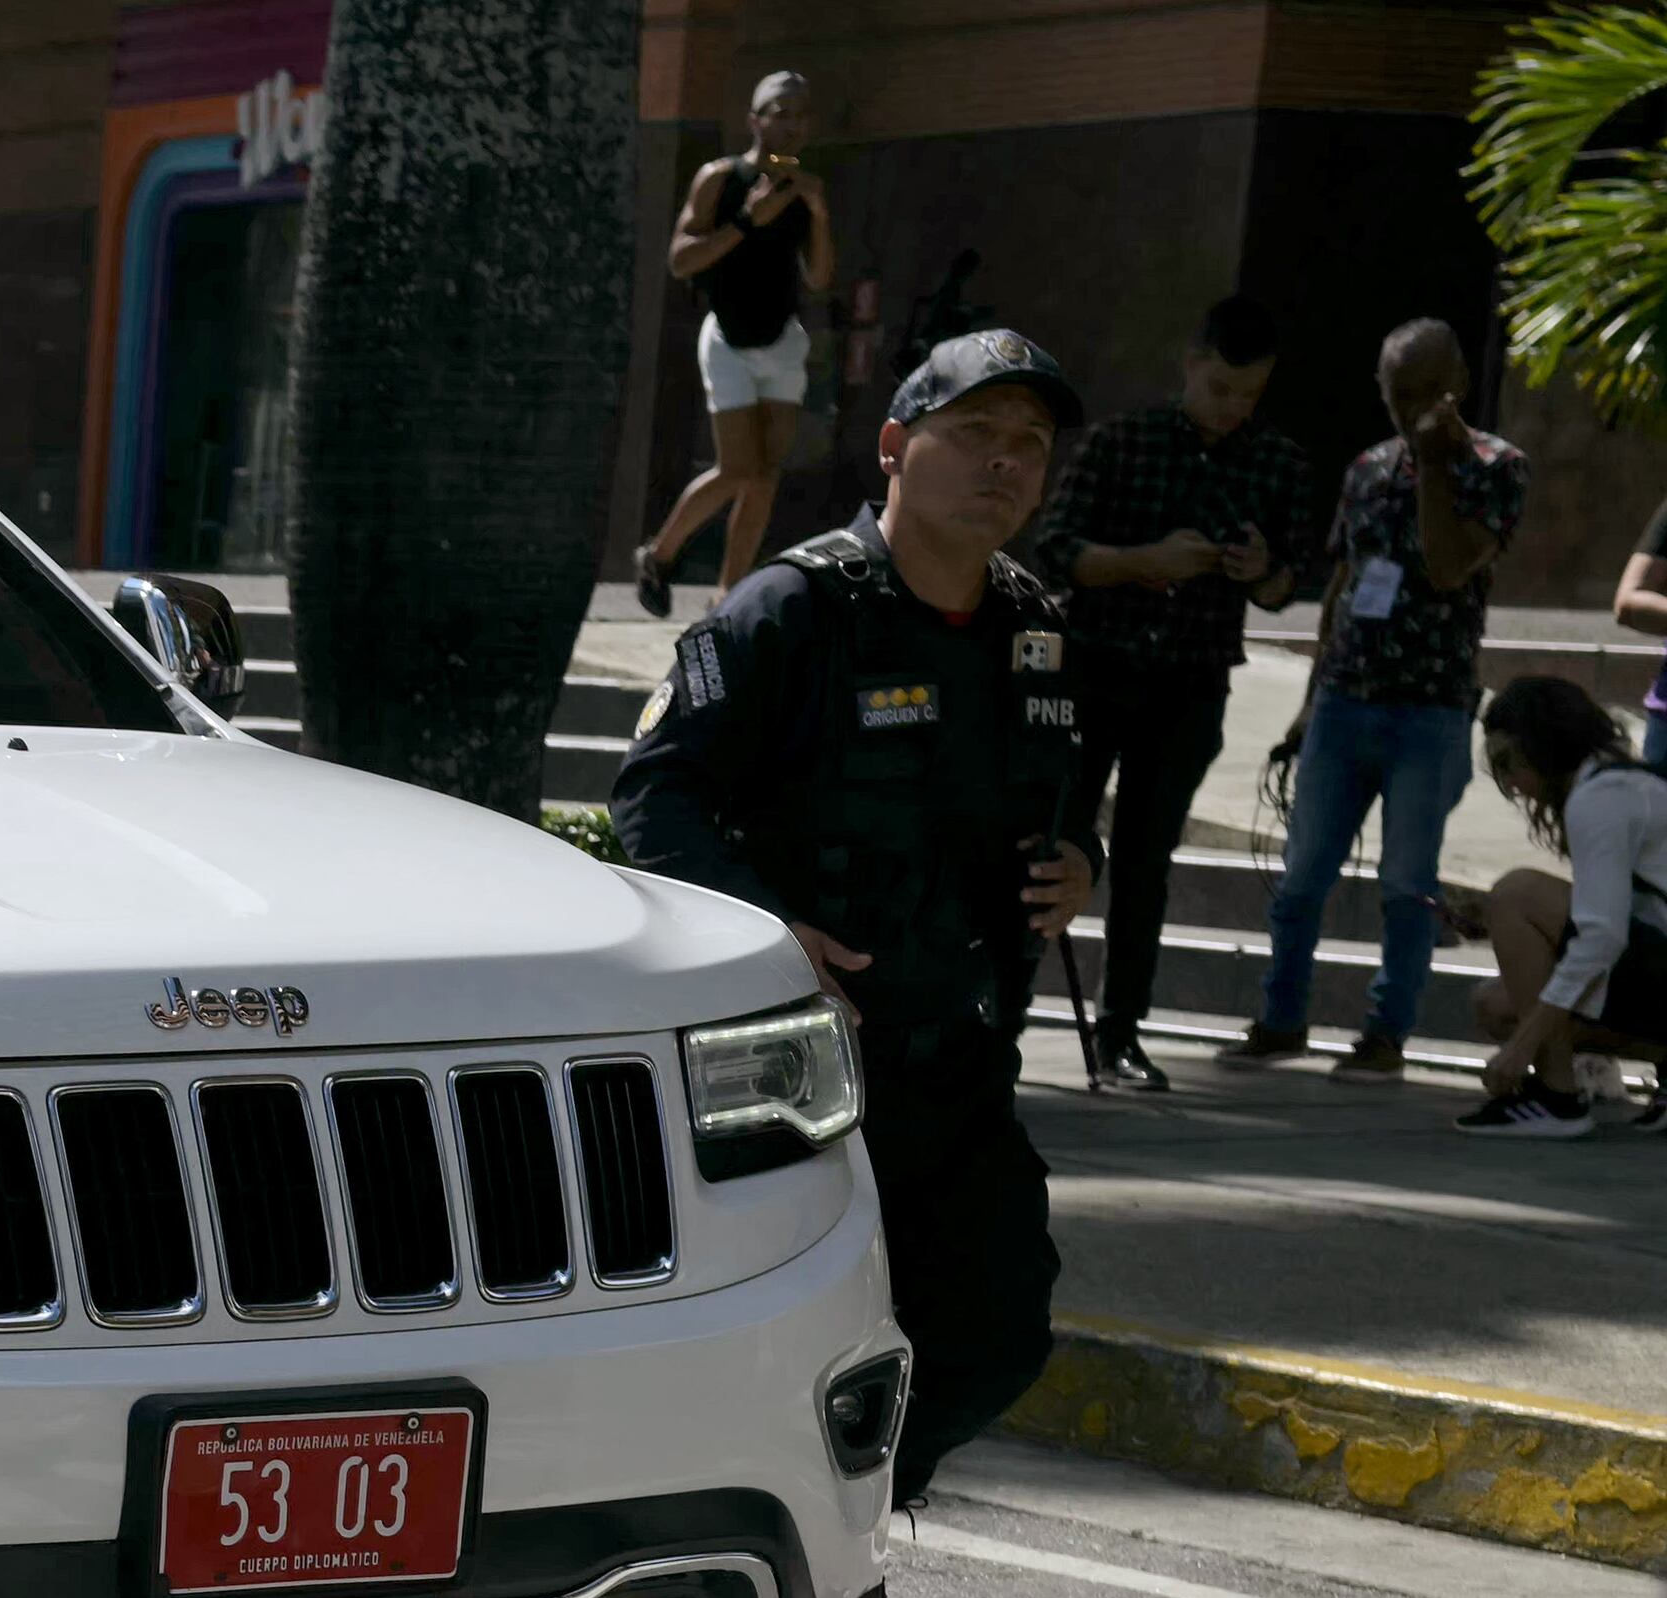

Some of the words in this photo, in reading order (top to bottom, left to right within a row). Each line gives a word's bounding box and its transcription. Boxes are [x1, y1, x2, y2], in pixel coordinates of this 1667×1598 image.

[1026, 696, 1075, 726] PNB
[144, 976, 310, 1038] Jeep
[267, 1433, 350, 1452] BOLIVARIANA
[354, 1433, 370, 1448] DE
[373, 1429, 445, 1447] VENEZUELA
[219, 1459, 292, 1547] 53
[334, 1453, 410, 1539] 03
[239, 1557, 288, 1575] CUERPO
[293, 1551, 380, 1570] DIPLOMATICO
